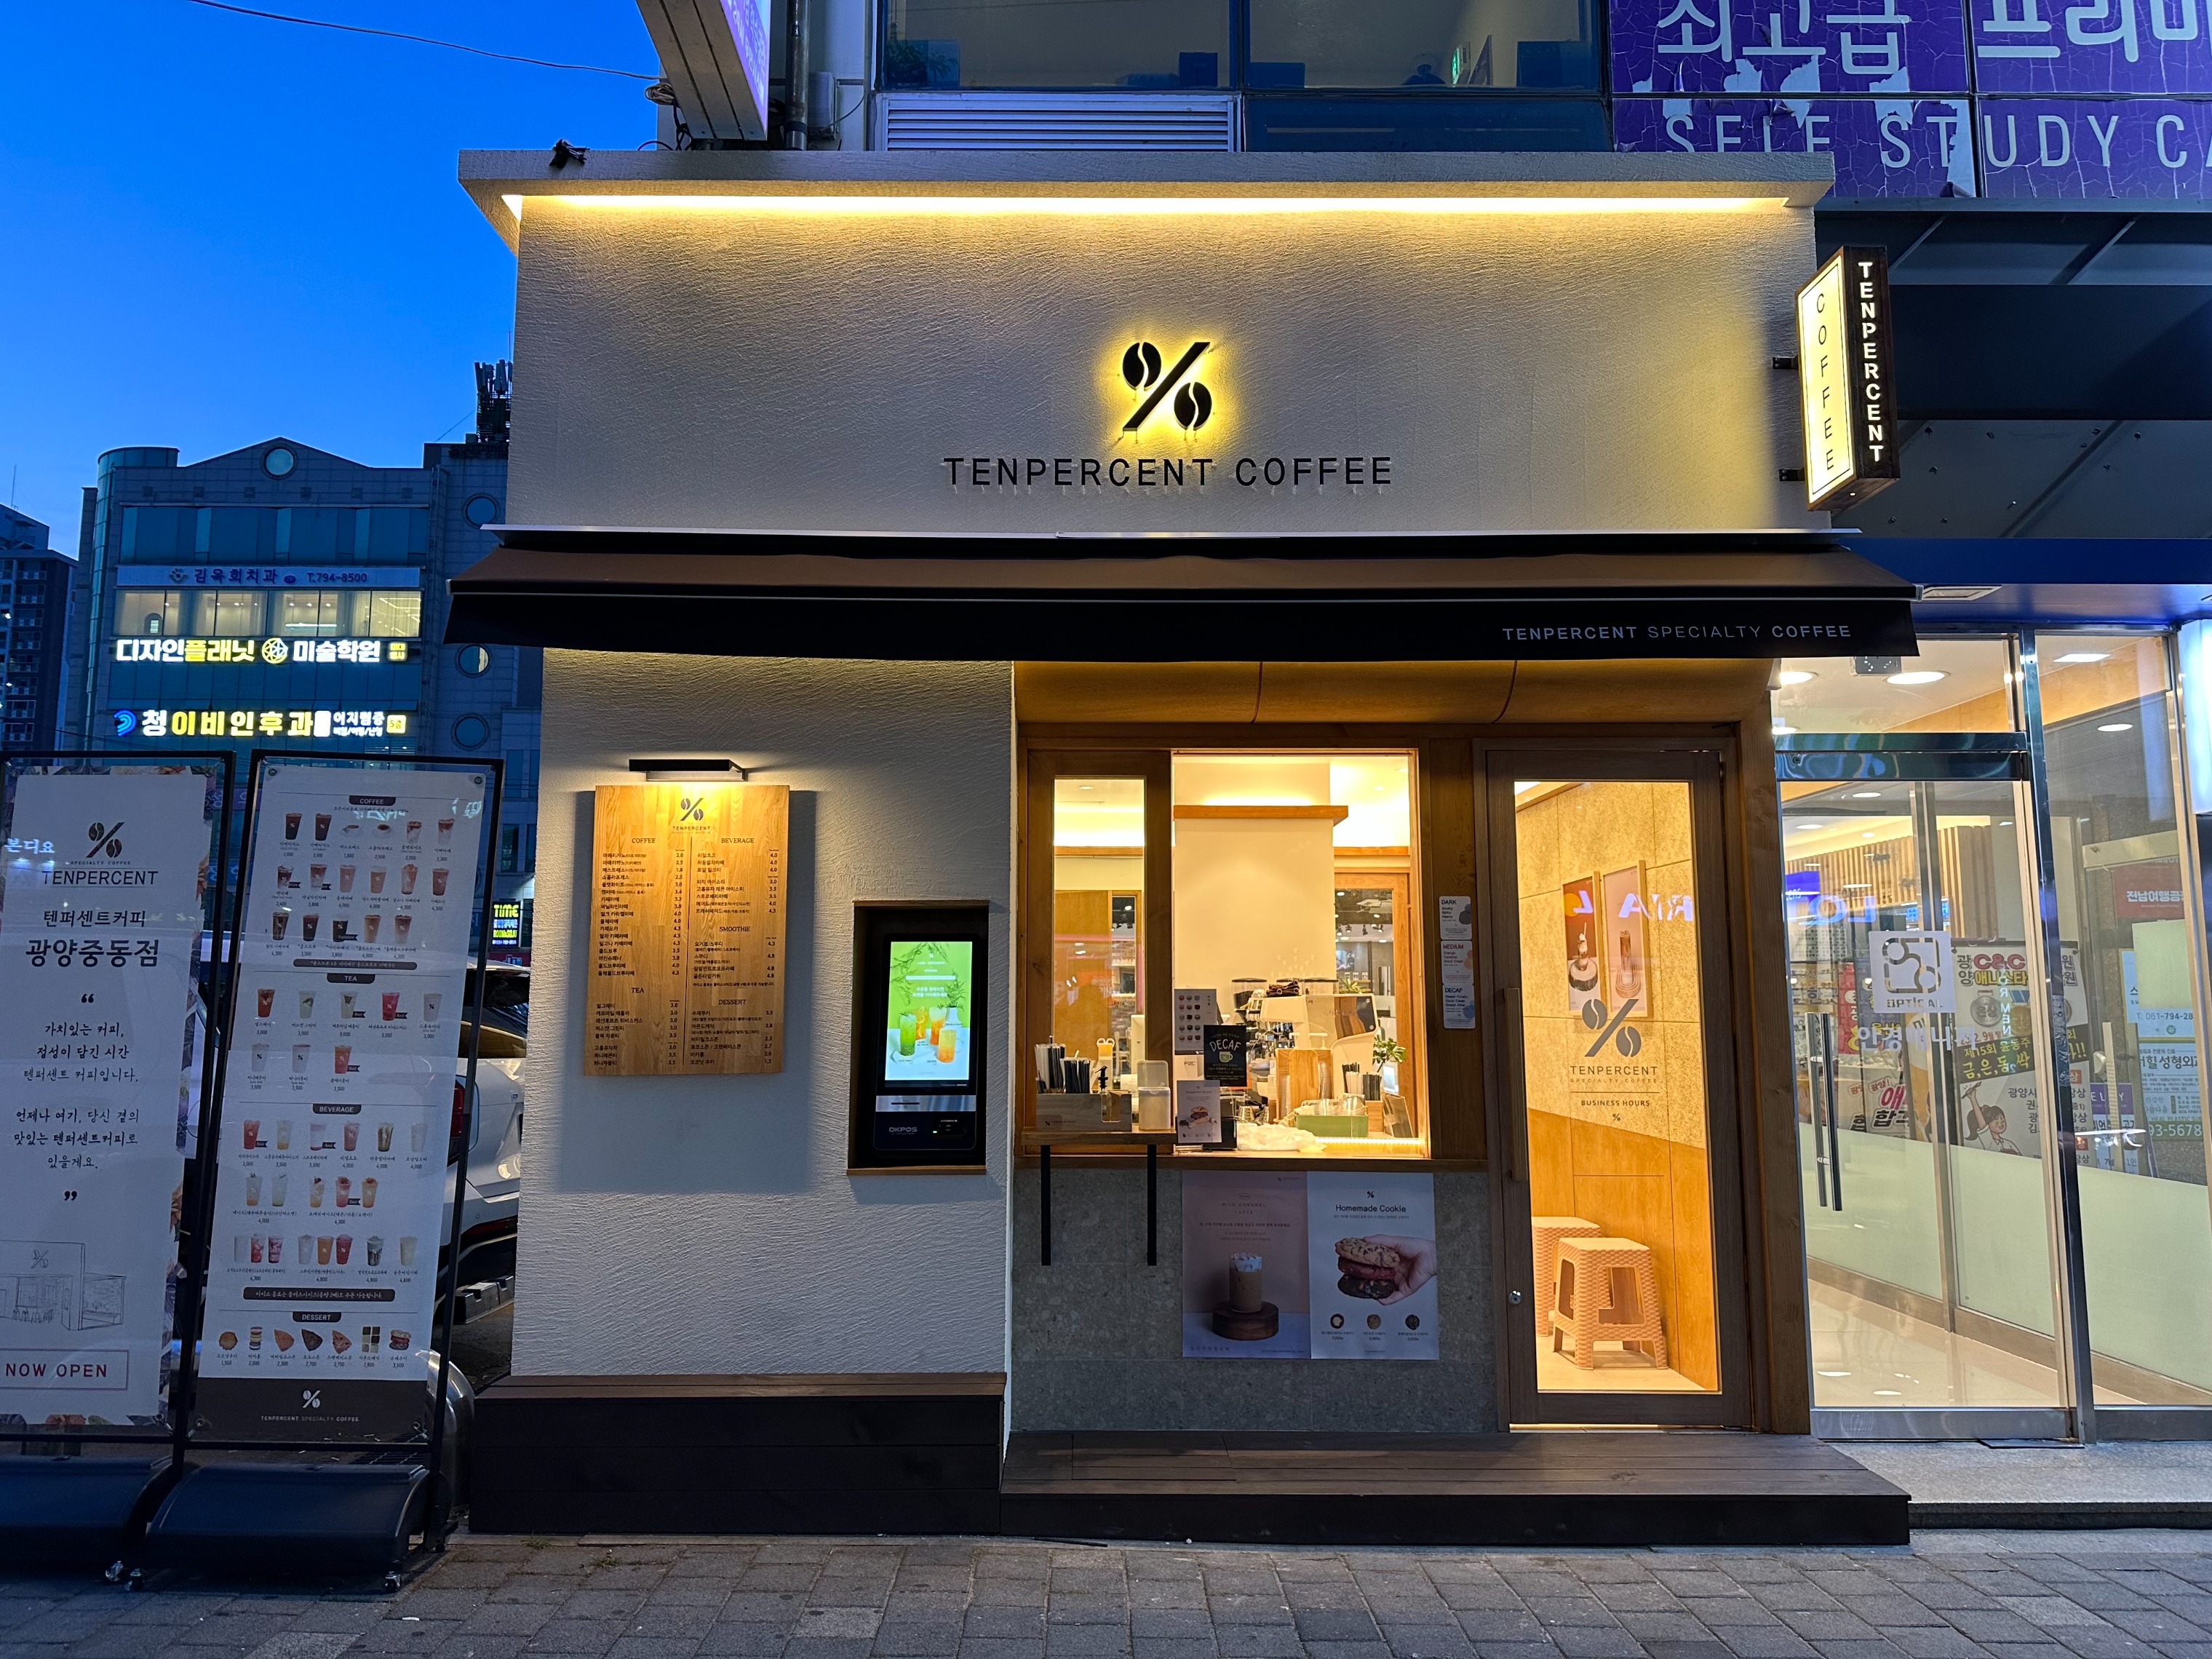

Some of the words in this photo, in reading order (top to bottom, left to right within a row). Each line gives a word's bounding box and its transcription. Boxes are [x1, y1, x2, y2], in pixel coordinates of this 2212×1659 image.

[1880, 115, 2119, 168] STUDY
[2156, 115, 2212, 168] C
[1858, 261, 1885, 462] TENPERCENT
[1816, 293, 1834, 471] COFFEE
[944, 457, 1213, 487] TENPERCENT
[1236, 456, 1391, 487] COFFEE
[306, 572, 367, 582] T.794-8500
[1503, 626, 1637, 641] TENPERCENT
[1648, 626, 1762, 639] SPECIALTY
[1772, 624, 1851, 638] COFFEE
[116, 639, 255, 662] 디자인플래닛
[293, 640, 381, 663] 미술학원
[42, 870, 159, 885] TENPERCENT
[44, 910, 146, 928] 텐퍼센트커피
[493, 904, 519, 918] TIME
[25, 939, 159, 968] 광양중동점
[1973, 953, 2026, 970] C&C
[45, 1022, 92, 1037] 가치있는
[98, 1022, 124, 1038] 커피,
[37, 1044, 71, 1059] 정성이
[76, 1044, 99, 1059] 담긴
[105, 1044, 130, 1059] 시간
[1209, 1038, 1242, 1052] DECAF
[24, 1067, 70, 1082] 텐퍼센트
[75, 1067, 138, 1083] 커피입니다.
[1570, 1065, 1658, 1075] TENPERCENT
[16, 1107, 51, 1123] 언제나
[55, 1107, 81, 1123] 여기,
[87, 1108, 110, 1123] 당신
[117, 1108, 139, 1123] 곁의
[319, 1105, 354, 1113] BEVERAGE
[14, 1130, 48, 1146] 맛있는
[53, 1131, 138, 1147] 텐퍼센트커피로
[48, 1154, 98, 1169] 있을게요.
[1335, 1204, 1377, 1212] Homemade
[1379, 1204, 1407, 1213] Cookie
[5, 1363, 46, 1377] NOW
[56, 1363, 108, 1377] OPEN
